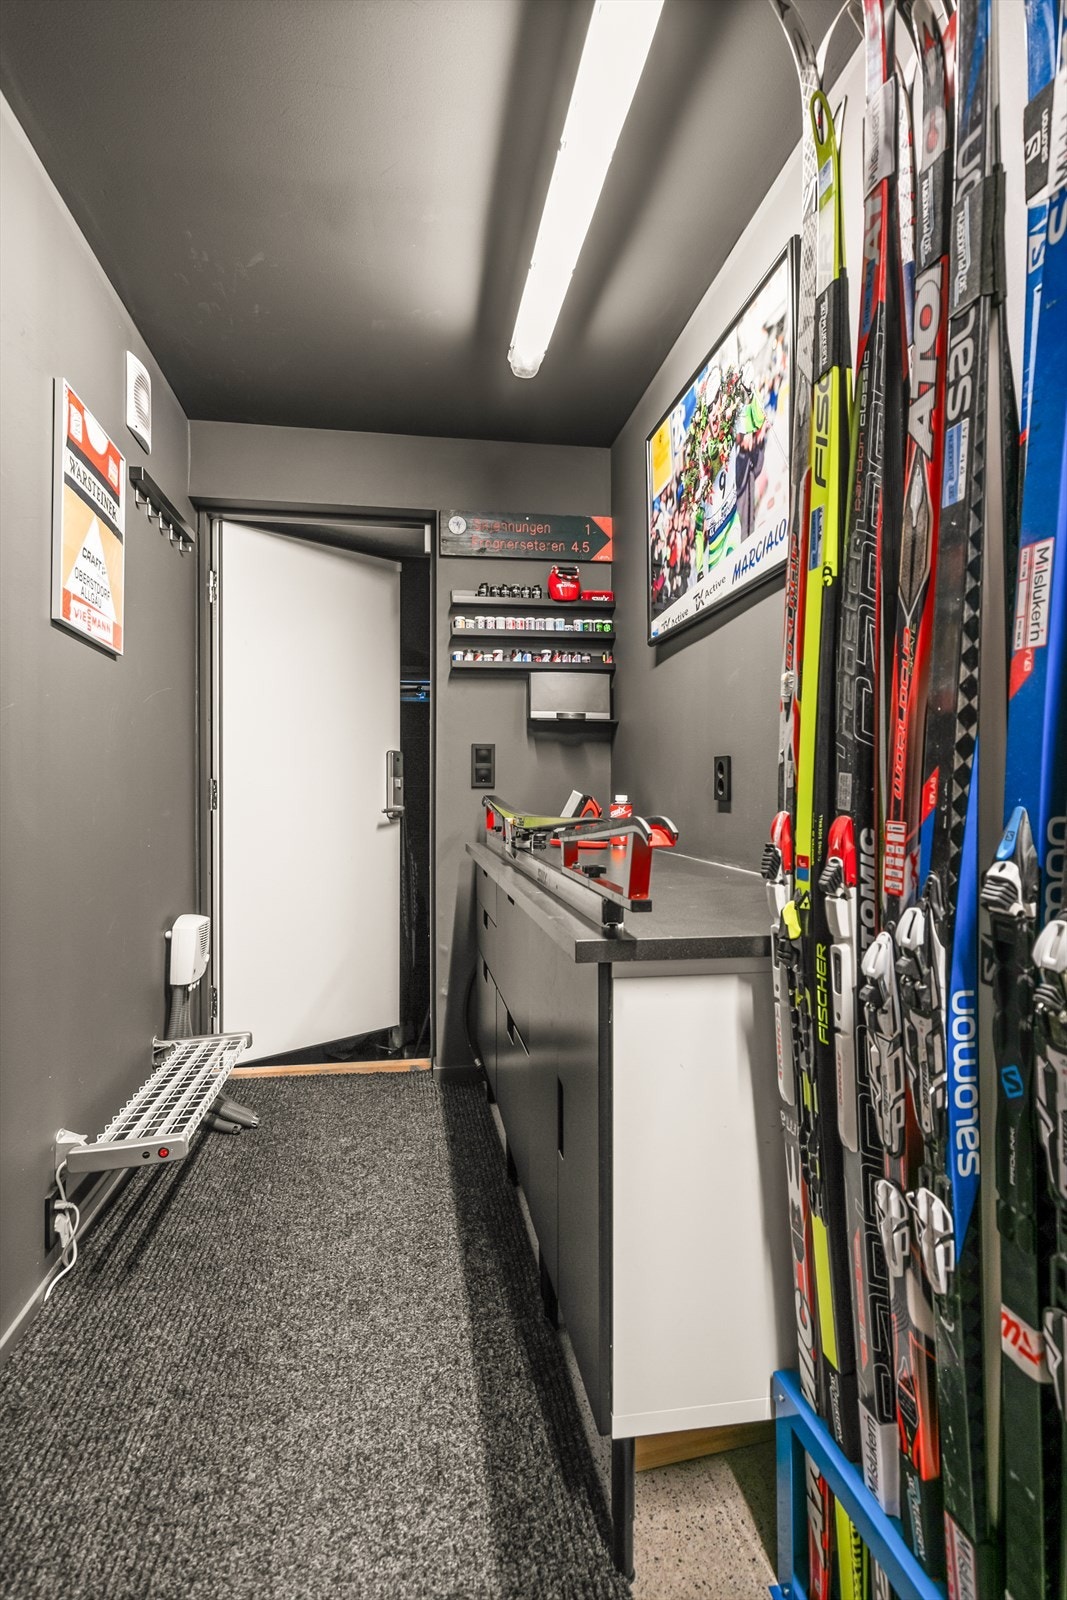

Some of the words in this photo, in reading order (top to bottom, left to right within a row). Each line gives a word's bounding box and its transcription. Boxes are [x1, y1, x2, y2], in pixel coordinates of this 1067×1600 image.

[1041, 108, 1049, 164] salomon
[957, 275, 967, 294] SKI
[858, 350, 870, 426] classic
[69, 455, 118, 523] WARSTEINER
[719, 471, 726, 499] 9
[585, 524, 592, 536] 1
[82, 547, 102, 571] CRAFT
[74, 566, 111, 601] OBERSTDORF
[705, 576, 727, 599] Active
[671, 608, 689, 626] Active
[907, 622, 917, 676] SKATE
[894, 626, 910, 801] WORLDCUP
[816, 943, 830, 1046] FISCHER
[951, 989, 980, 1178] salomon
